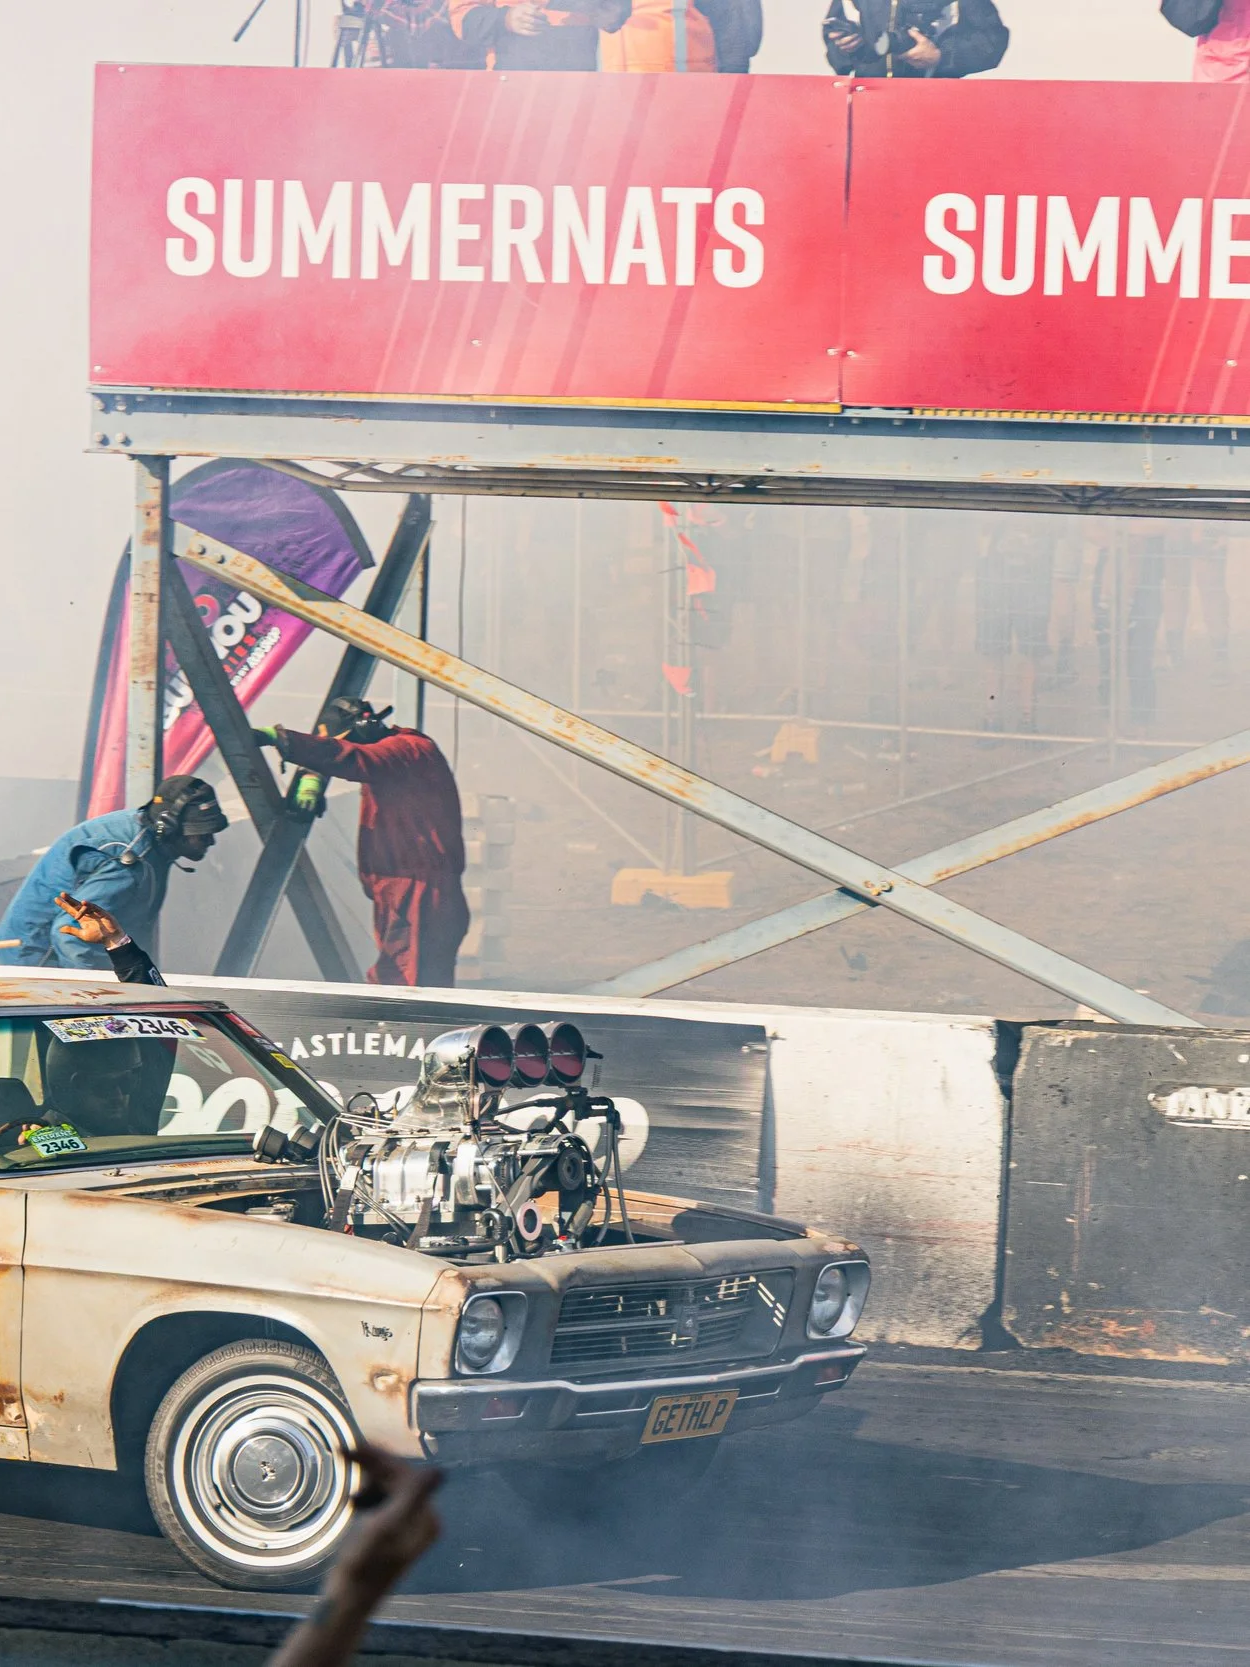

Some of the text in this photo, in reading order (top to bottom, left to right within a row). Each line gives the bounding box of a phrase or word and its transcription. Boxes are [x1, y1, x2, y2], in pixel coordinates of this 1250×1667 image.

[166, 177, 765, 288] SUMMERNATS
[922, 192, 1250, 299] SUMME
[128, 1018, 190, 1037] 2346
[274, 1032, 425, 1061] ASTLEMA
[41, 1138, 80, 1154] 2346
[651, 1398, 729, 1436] GETHLP
